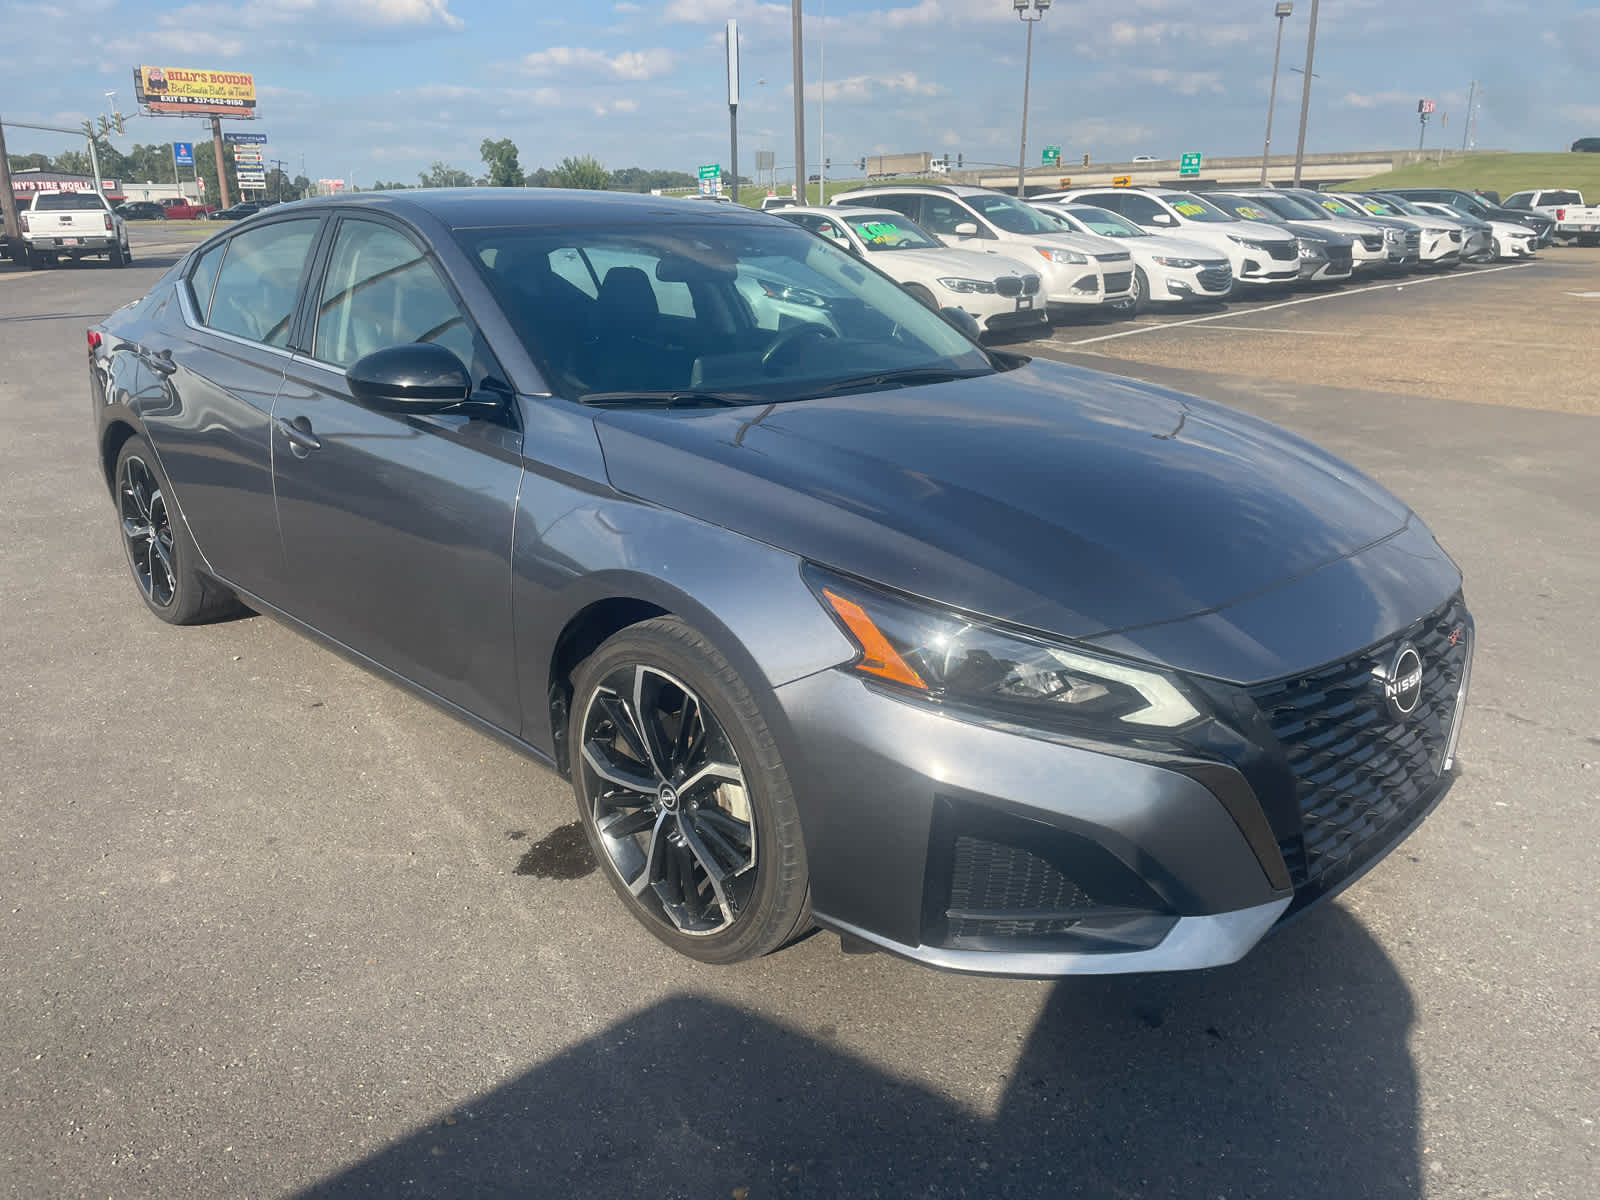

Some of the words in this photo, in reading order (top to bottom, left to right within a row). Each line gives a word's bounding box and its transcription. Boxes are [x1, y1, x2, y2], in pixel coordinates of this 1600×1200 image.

[167, 71, 208, 83] BILLY'S
[209, 74, 252, 86] BOUDIN
[160, 95, 178, 103] EXIT
[38, 181, 58, 191] TIRE
